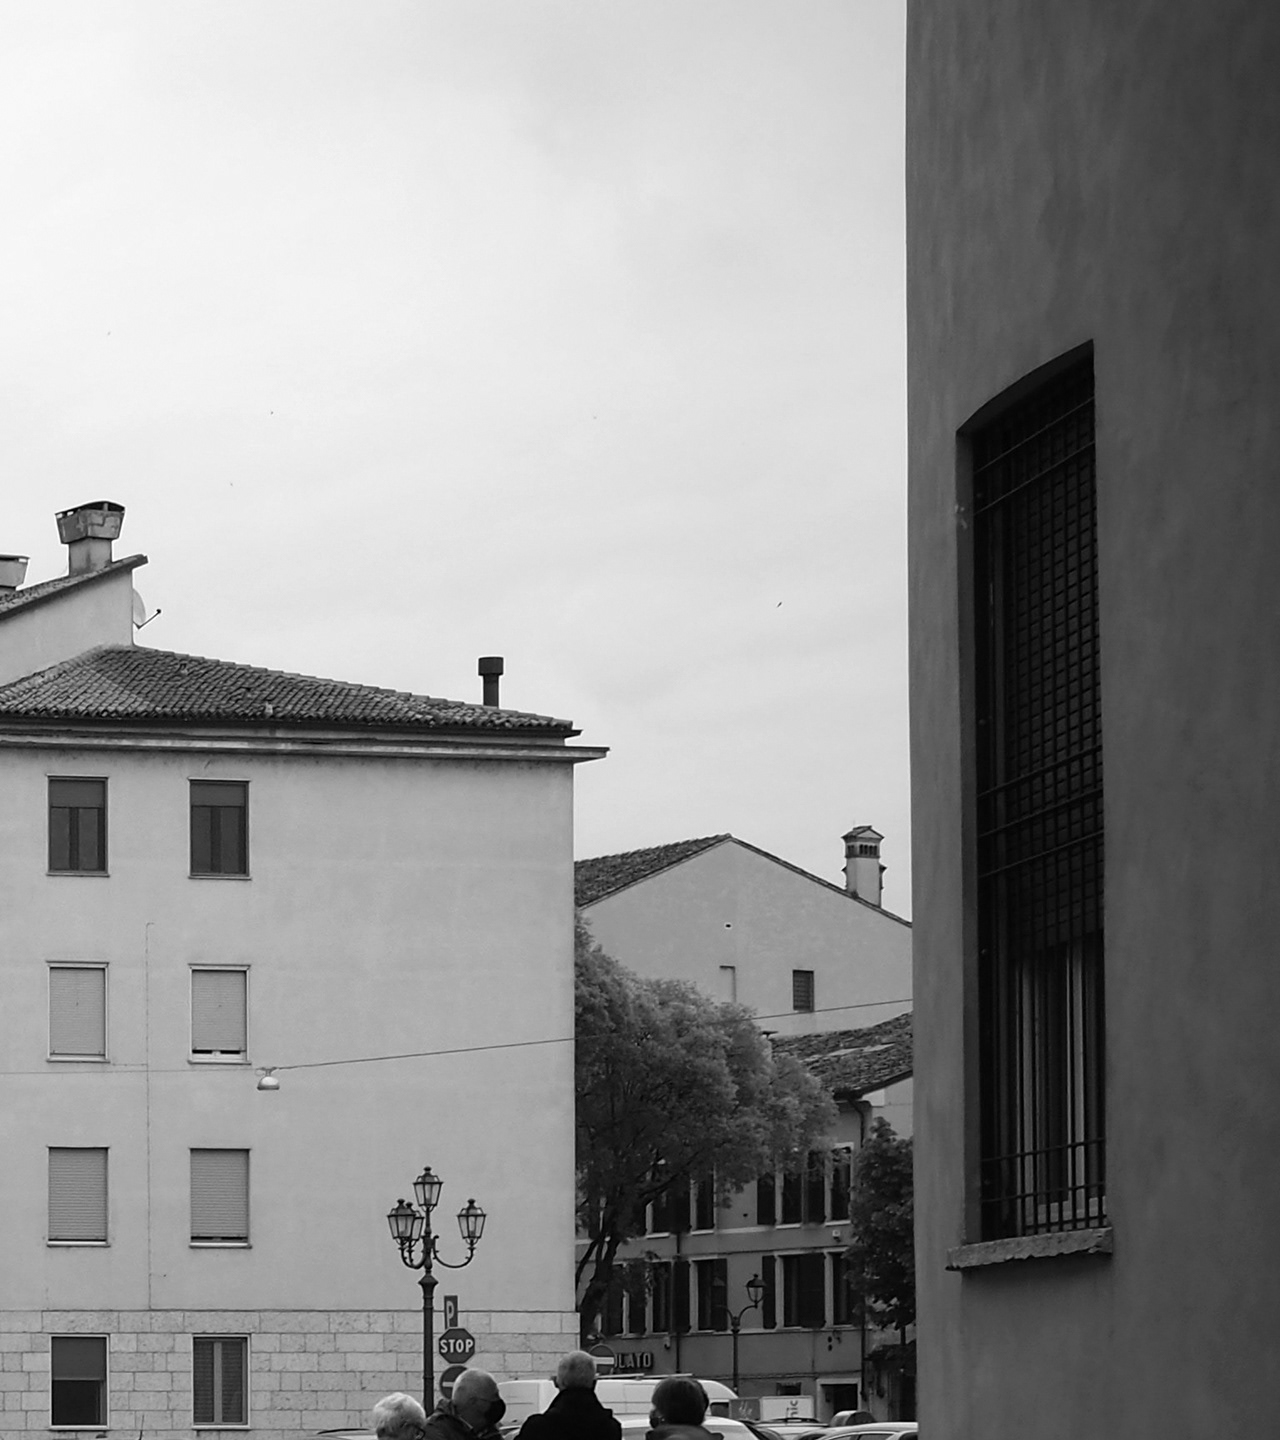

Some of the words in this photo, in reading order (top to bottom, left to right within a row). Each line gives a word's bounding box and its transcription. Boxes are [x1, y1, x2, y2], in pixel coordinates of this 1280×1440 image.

[446, 1301, 454, 1327] P
[440, 1339, 474, 1353] STOP
[614, 1352, 652, 1368] LATO
